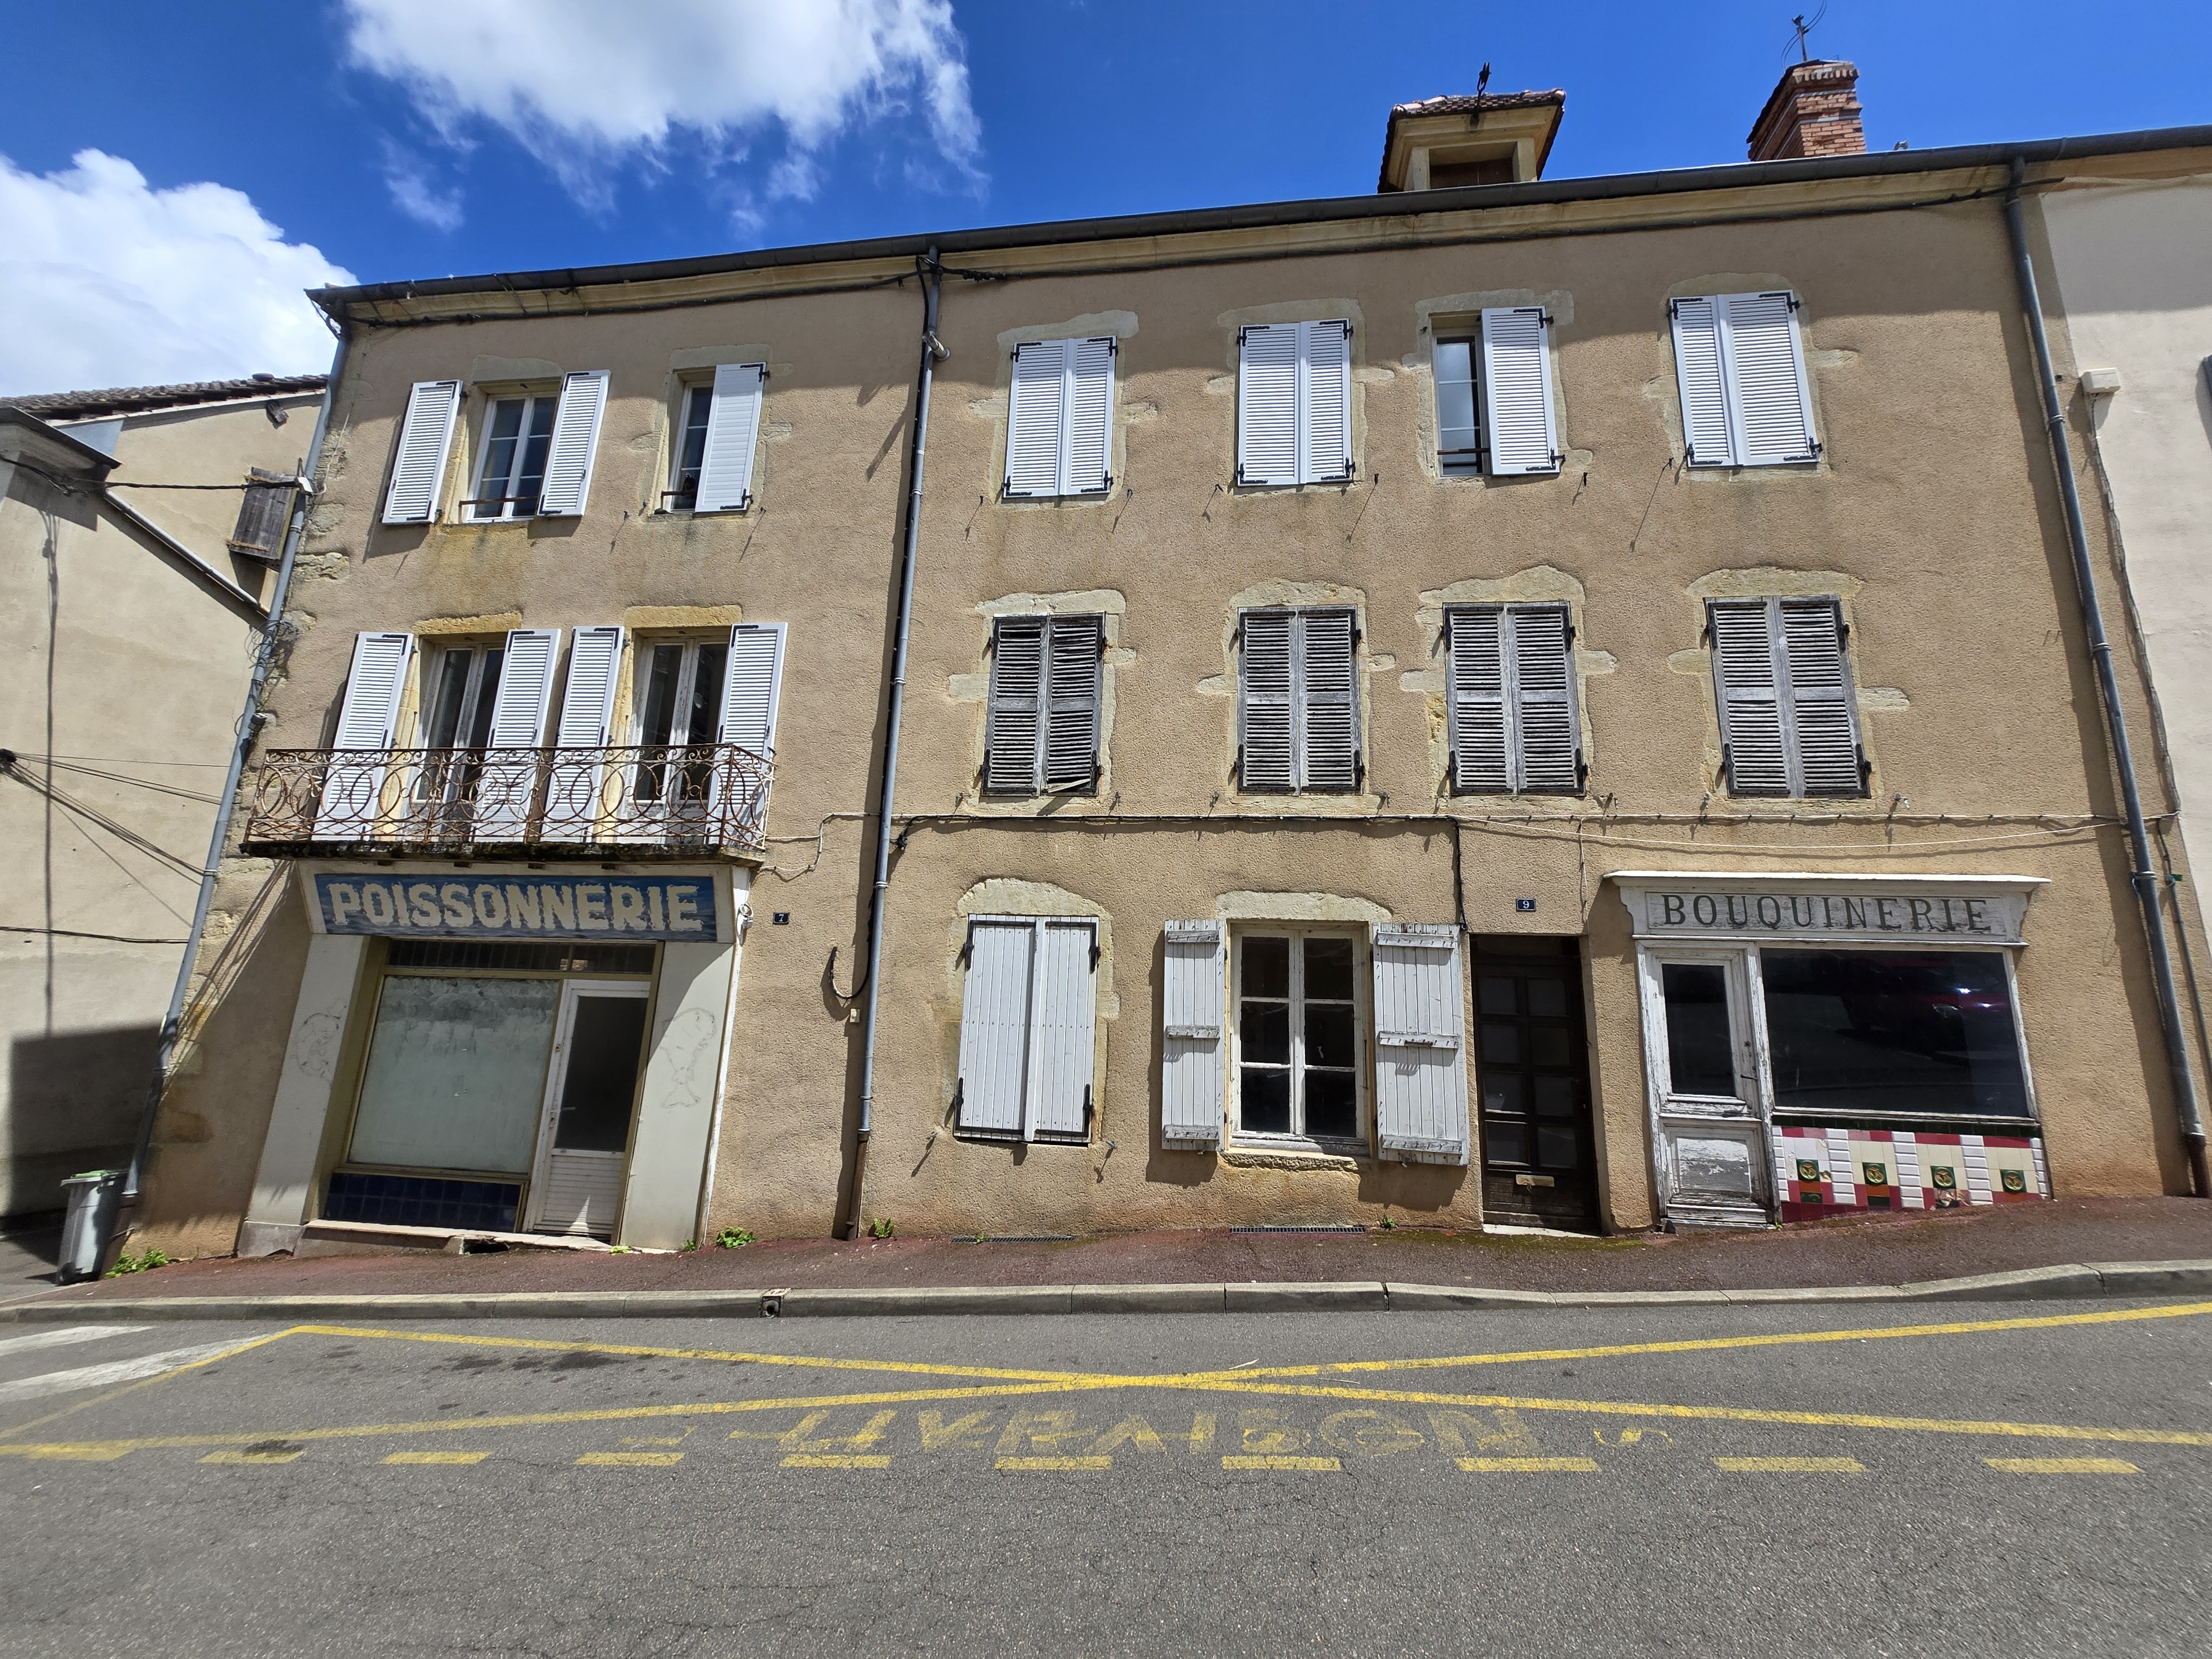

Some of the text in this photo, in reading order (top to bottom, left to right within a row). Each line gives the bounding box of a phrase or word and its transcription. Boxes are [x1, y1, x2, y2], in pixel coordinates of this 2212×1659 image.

[327, 882, 704, 932] POISSONNERIE
[1522, 900, 1530, 909] 9
[1661, 894, 1992, 931] BOUQUINERIE
[778, 914, 785, 922] 7
